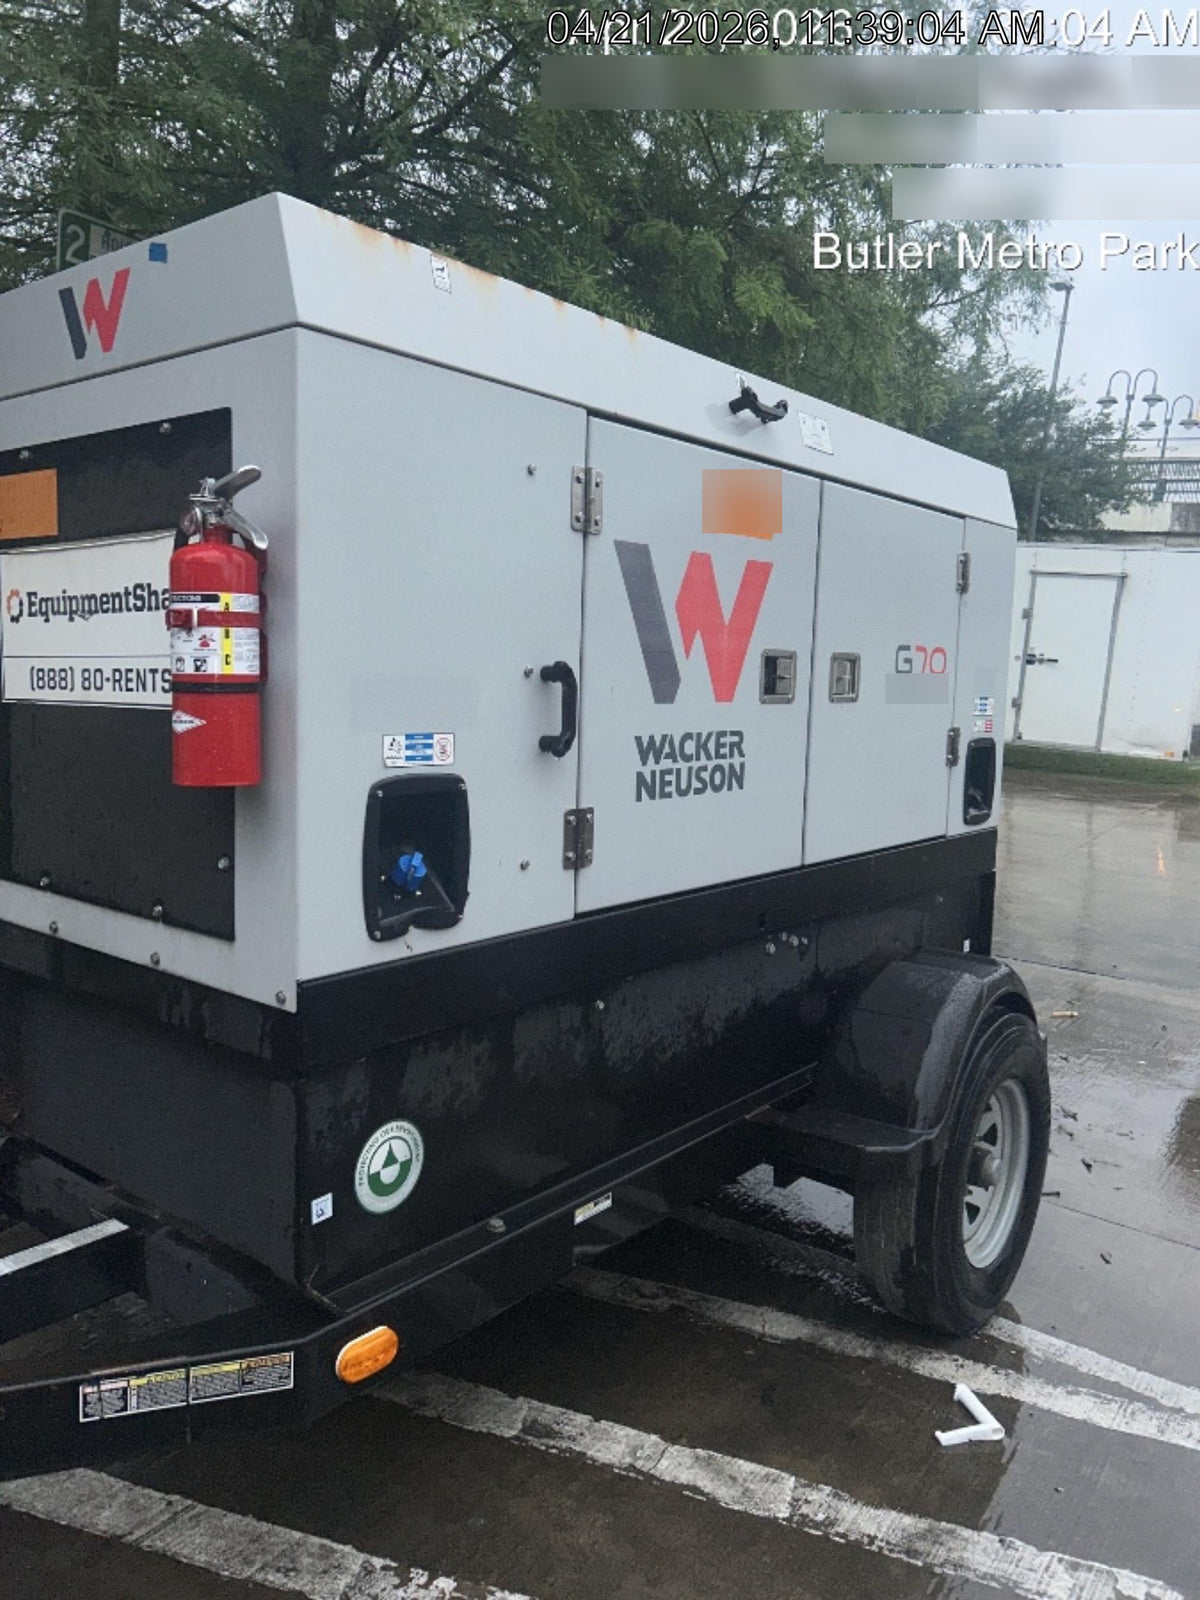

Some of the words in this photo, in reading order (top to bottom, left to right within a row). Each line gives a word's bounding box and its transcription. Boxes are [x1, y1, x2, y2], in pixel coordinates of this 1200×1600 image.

[65, 223, 86, 264] 2
[895, 645, 947, 674] G70
[30, 666, 75, 692] (888)
[81, 668, 172, 694] 80-RENTS
[634, 730, 746, 767] WACKER
[635, 761, 746, 802] NEUSON
